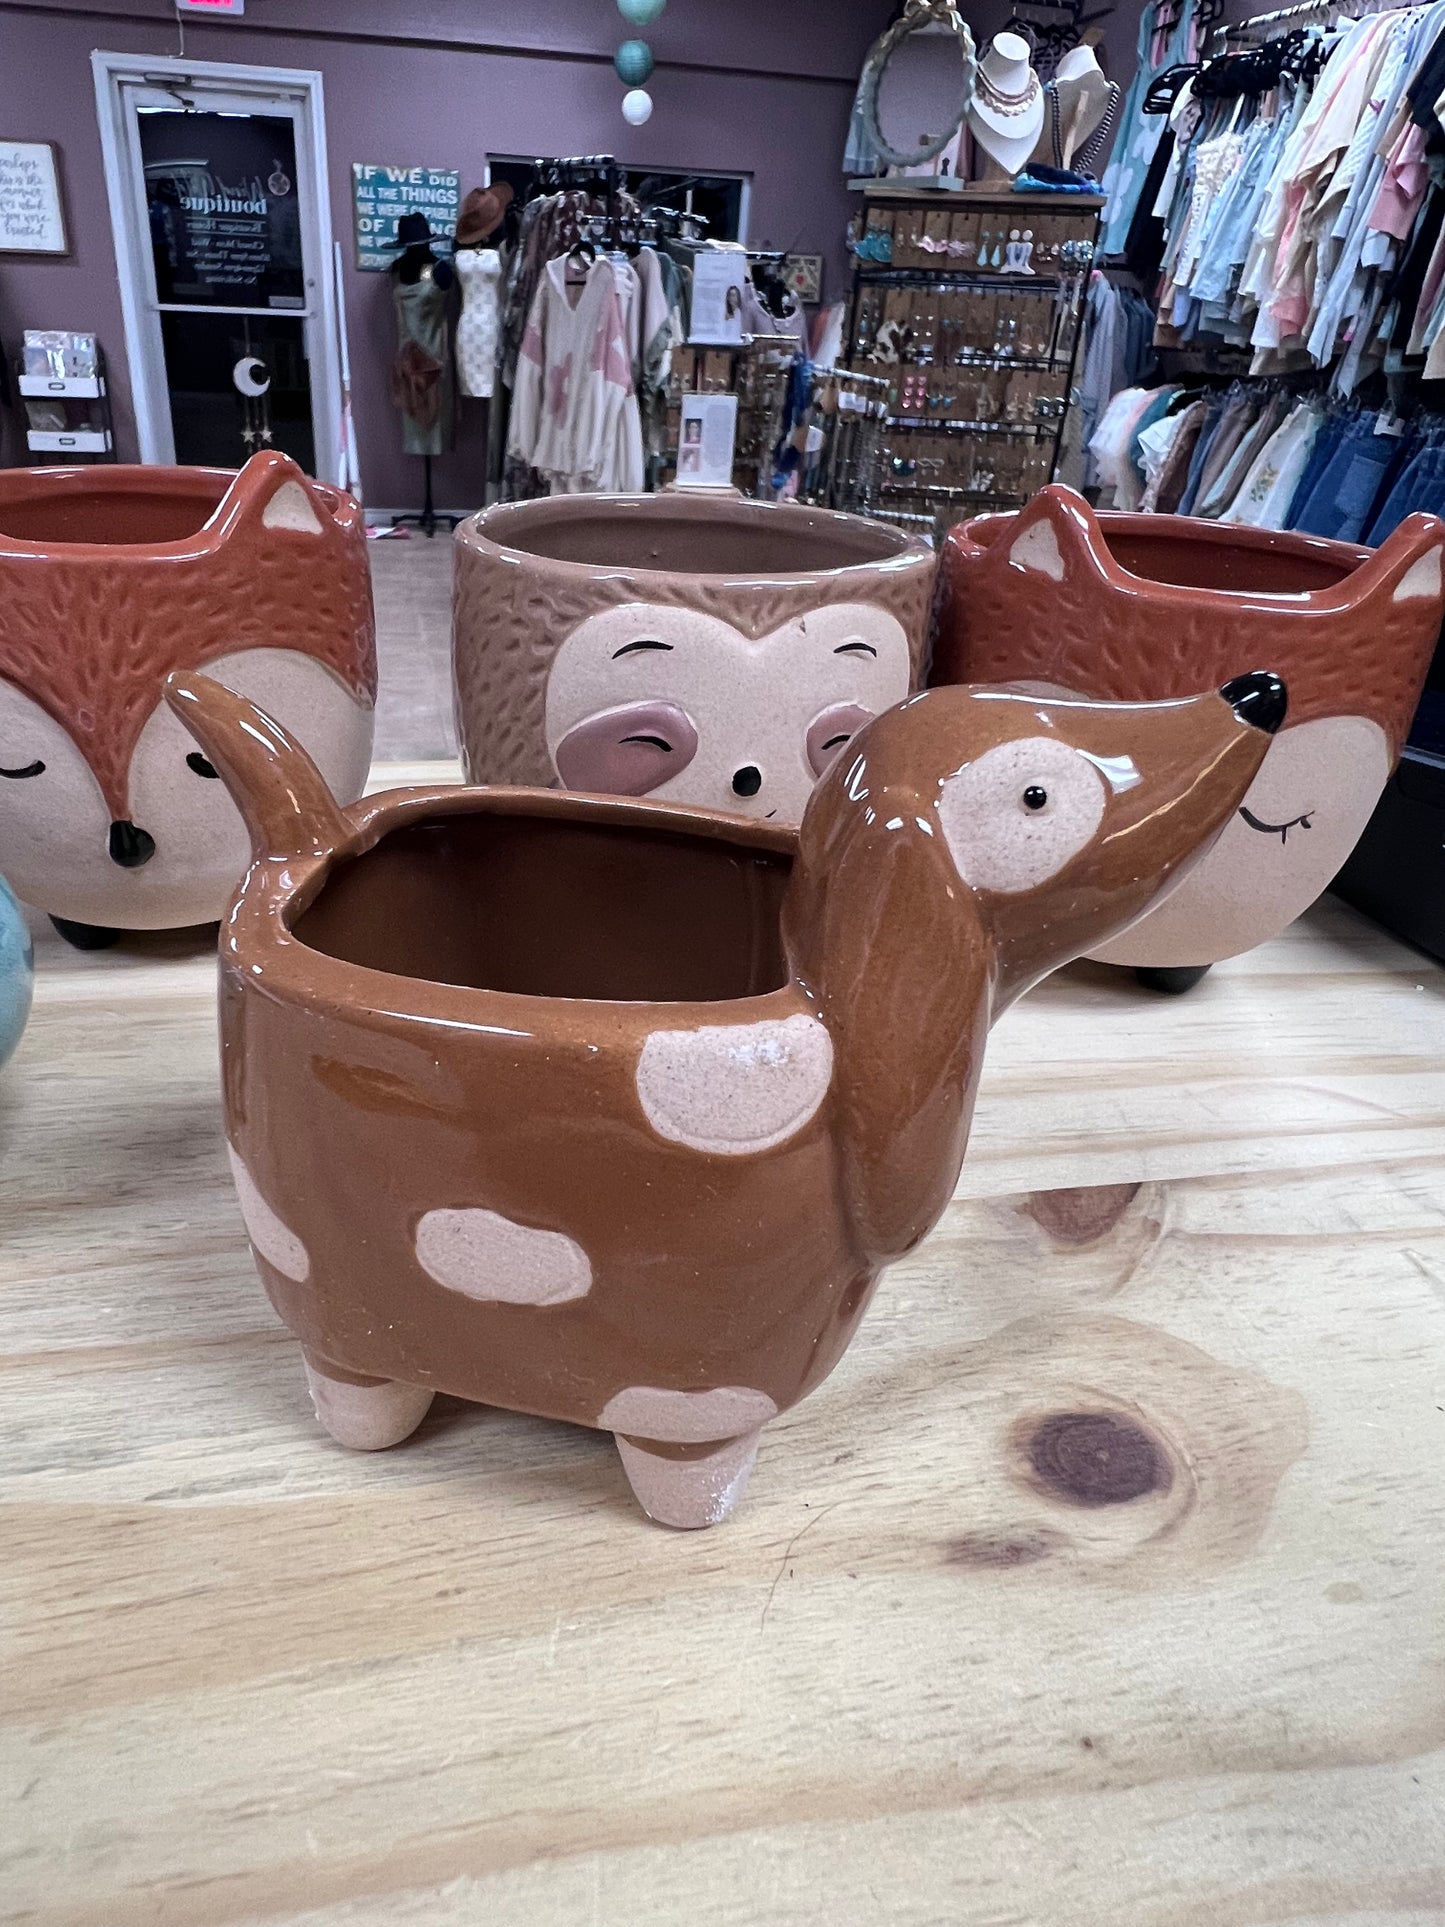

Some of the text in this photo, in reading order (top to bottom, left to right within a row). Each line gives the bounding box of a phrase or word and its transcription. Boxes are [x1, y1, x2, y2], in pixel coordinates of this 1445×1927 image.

[353, 163, 458, 187] IF WE DID
[357, 186, 458, 205] ALL THE THINGS
[359, 217, 384, 232] OF
